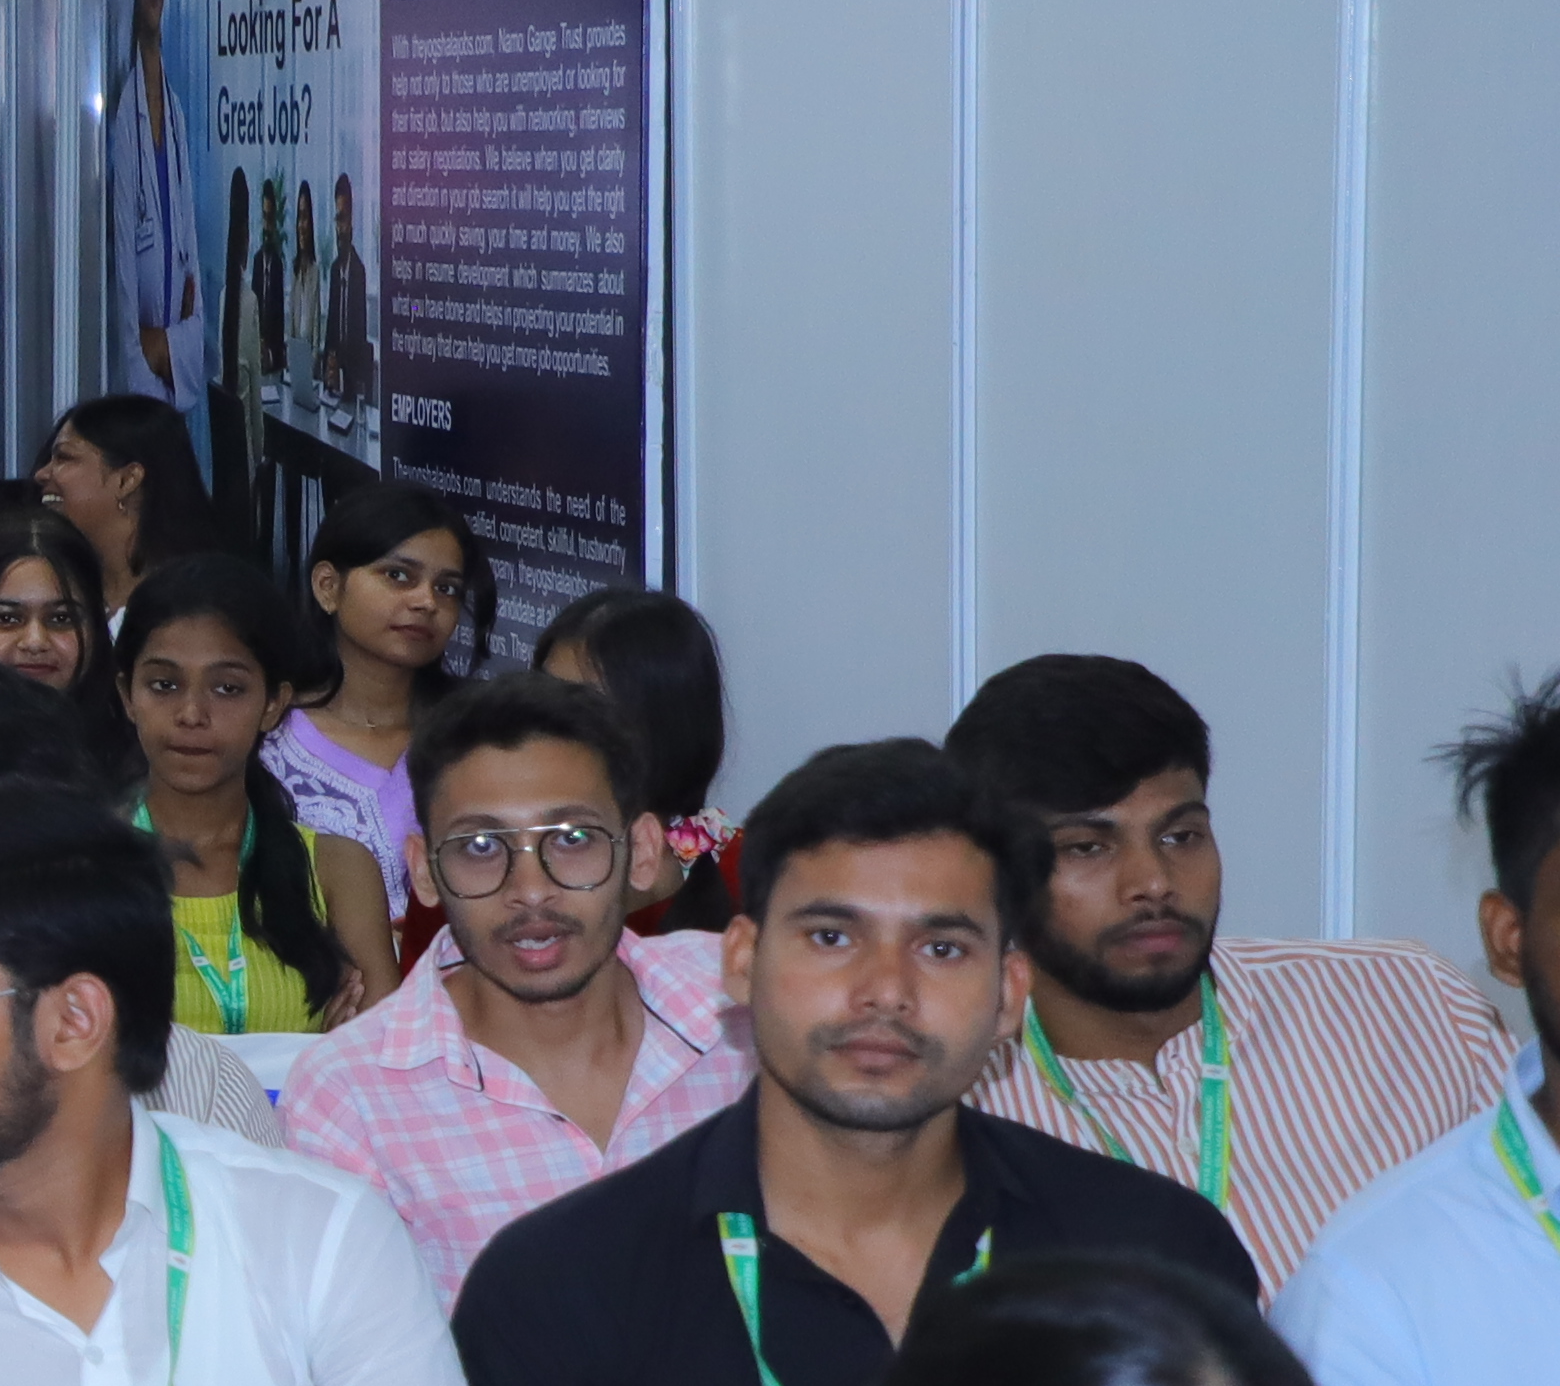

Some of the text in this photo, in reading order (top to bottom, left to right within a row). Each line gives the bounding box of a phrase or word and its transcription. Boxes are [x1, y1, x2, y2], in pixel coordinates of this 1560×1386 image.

[498, 27, 523, 54] Namo
[527, 24, 556, 58] Gange
[560, 22, 583, 49] Trust
[586, 19, 625, 53] provides
[217, 84, 313, 146] Great Job?
[392, 393, 451, 431] EMPLOYERS
[487, 477, 541, 510] understands
[546, 485, 562, 513] the
[567, 493, 590, 519] need
[595, 494, 605, 521] of
[610, 495, 626, 526] the
[500, 522, 546, 553] competent,
[578, 532, 626, 575] trustworthy
